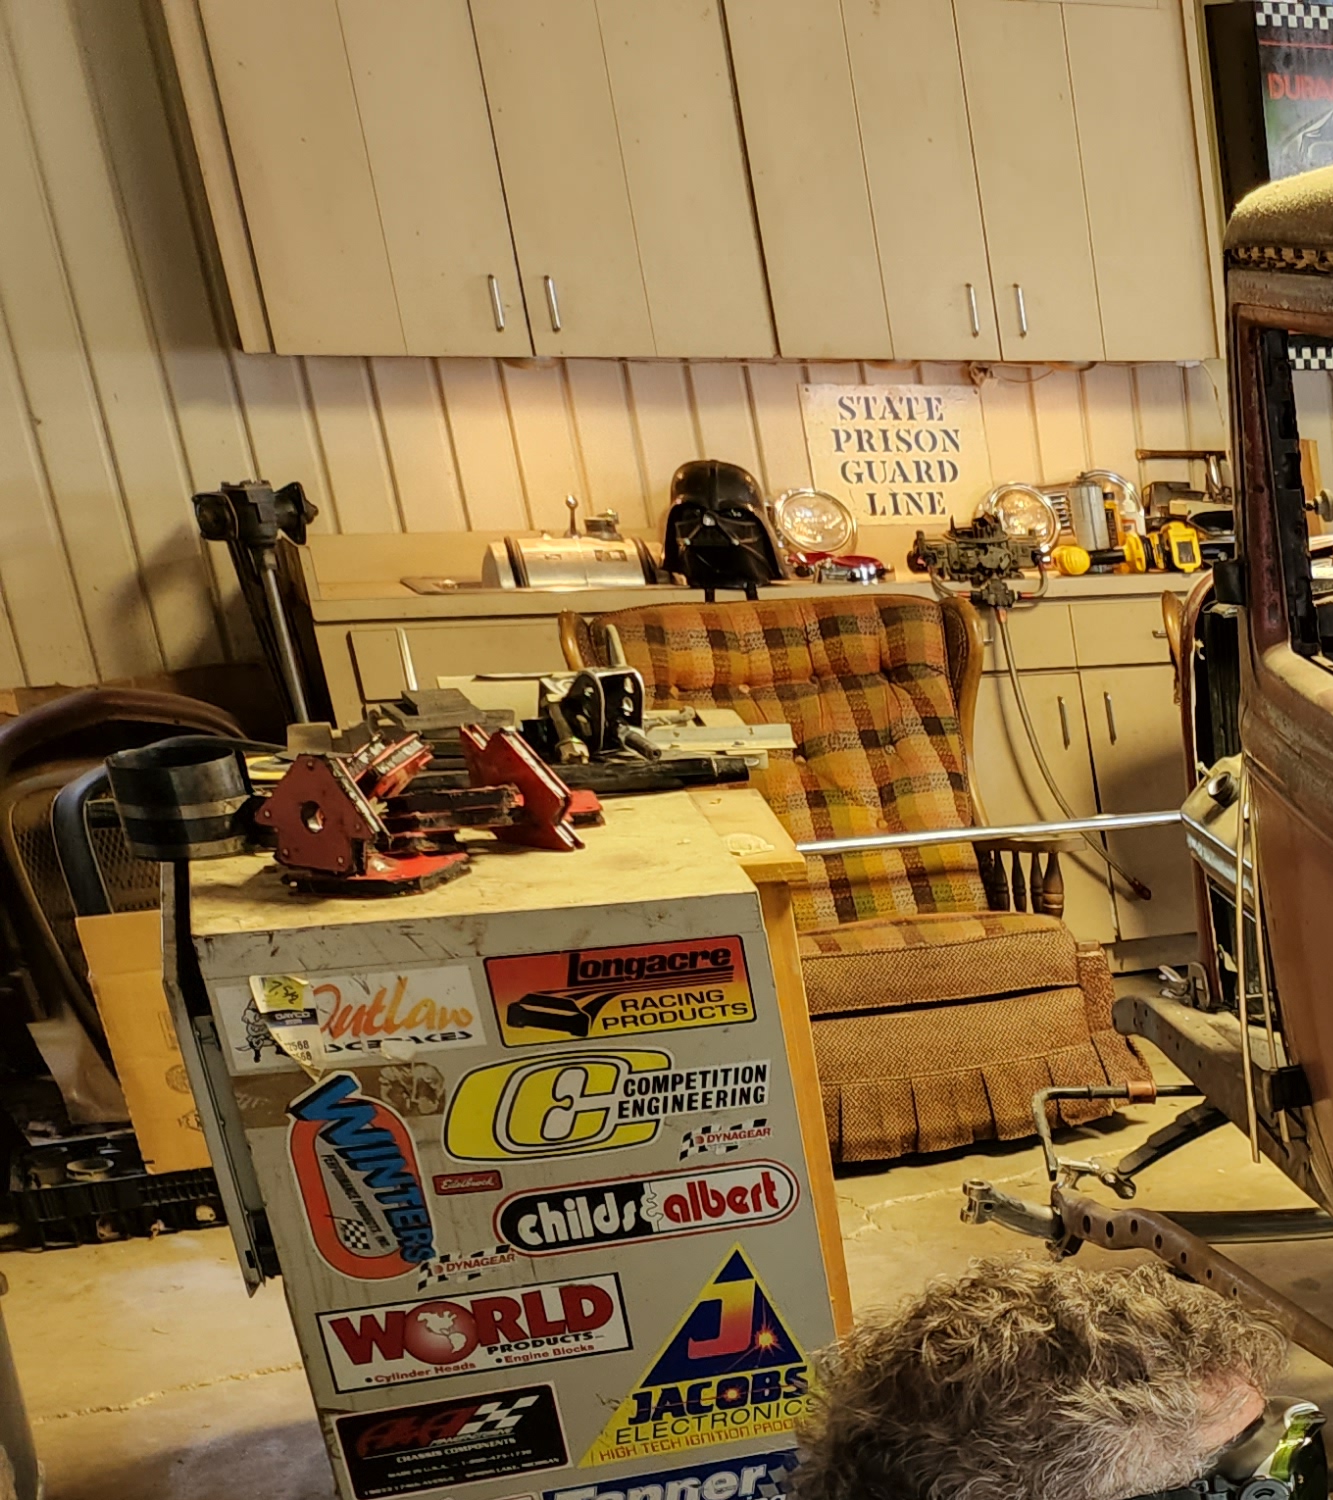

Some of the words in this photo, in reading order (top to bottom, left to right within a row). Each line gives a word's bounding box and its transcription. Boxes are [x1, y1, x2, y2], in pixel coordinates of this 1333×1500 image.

[838, 396, 944, 421] STATE
[831, 429, 960, 453] PRISON
[841, 460, 958, 484] GUARD
[866, 492, 946, 516] LINE
[567, 947, 732, 987] Longacre
[621, 989, 725, 1012] RACING
[601, 1002, 748, 1030] PRODUCTS
[366, 1031, 473, 1049] BAKES
[623, 1063, 768, 1097] COMPETITION
[617, 1085, 766, 1119] ENGINEERING
[706, 1127, 772, 1145] DYNAGEAR
[286, 1074, 437, 1264] WINTERS
[517, 1192, 637, 1246] childs
[663, 1171, 780, 1225] albert
[446, 1253, 516, 1274] DYNAGEAR
[328, 1283, 615, 1366] WORLD
[486, 1331, 594, 1355] PRODUCTS
[504, 1349, 549, 1364] Engine
[552, 1343, 595, 1356] Blocks
[374, 1368, 432, 1384] Cylinder
[434, 1360, 476, 1375] Heads
[628, 1366, 808, 1426] JACOBS
[444, 1438, 517, 1455] COMPONENTS
[599, 1444, 637, 1462] HIGH
[643, 1437, 682, 1454] TECH
[685, 1425, 750, 1447] IGNITION
[753, 1416, 799, 1436] PROD
